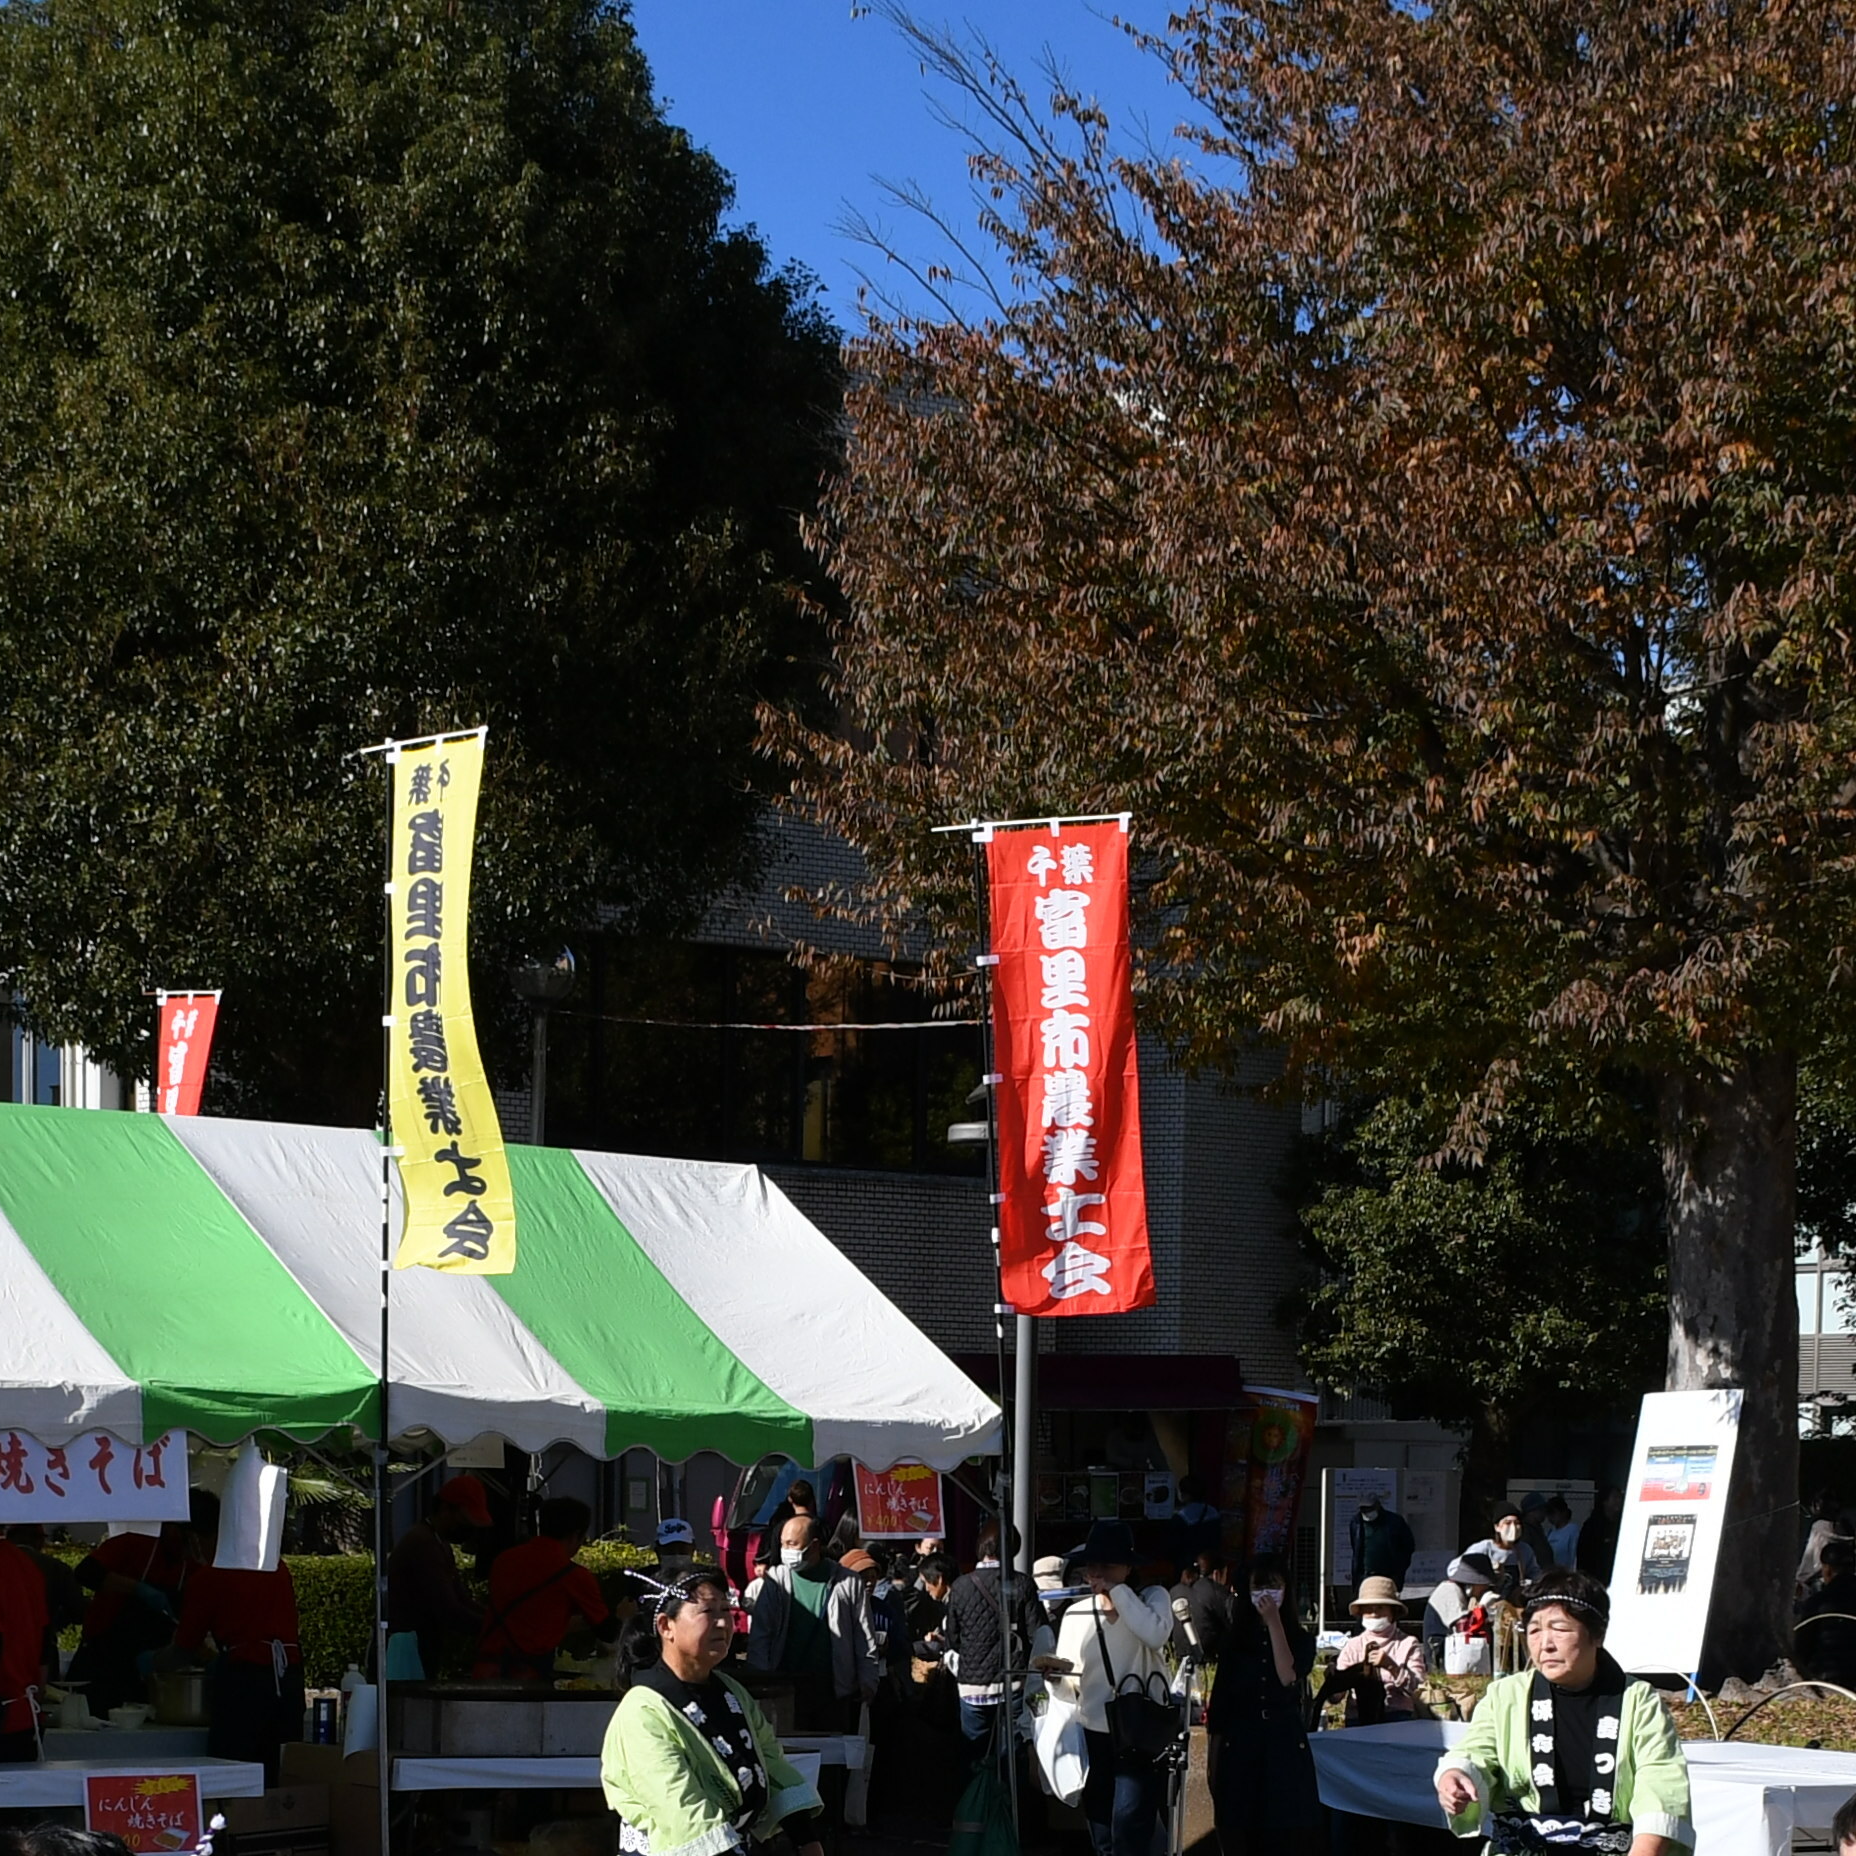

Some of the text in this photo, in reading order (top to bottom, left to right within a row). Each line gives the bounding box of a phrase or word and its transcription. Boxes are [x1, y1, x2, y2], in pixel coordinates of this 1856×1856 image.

[1026, 843, 1094, 886] 千葉
[1033, 888, 1113, 1301] 富里市農業士会
[864, 1479, 907, 1496] にんじん
[1531, 1698, 1555, 1787] 保存会
[98, 1794, 155, 1812] にんじん
[127, 1810, 185, 1830] 焼きそば
